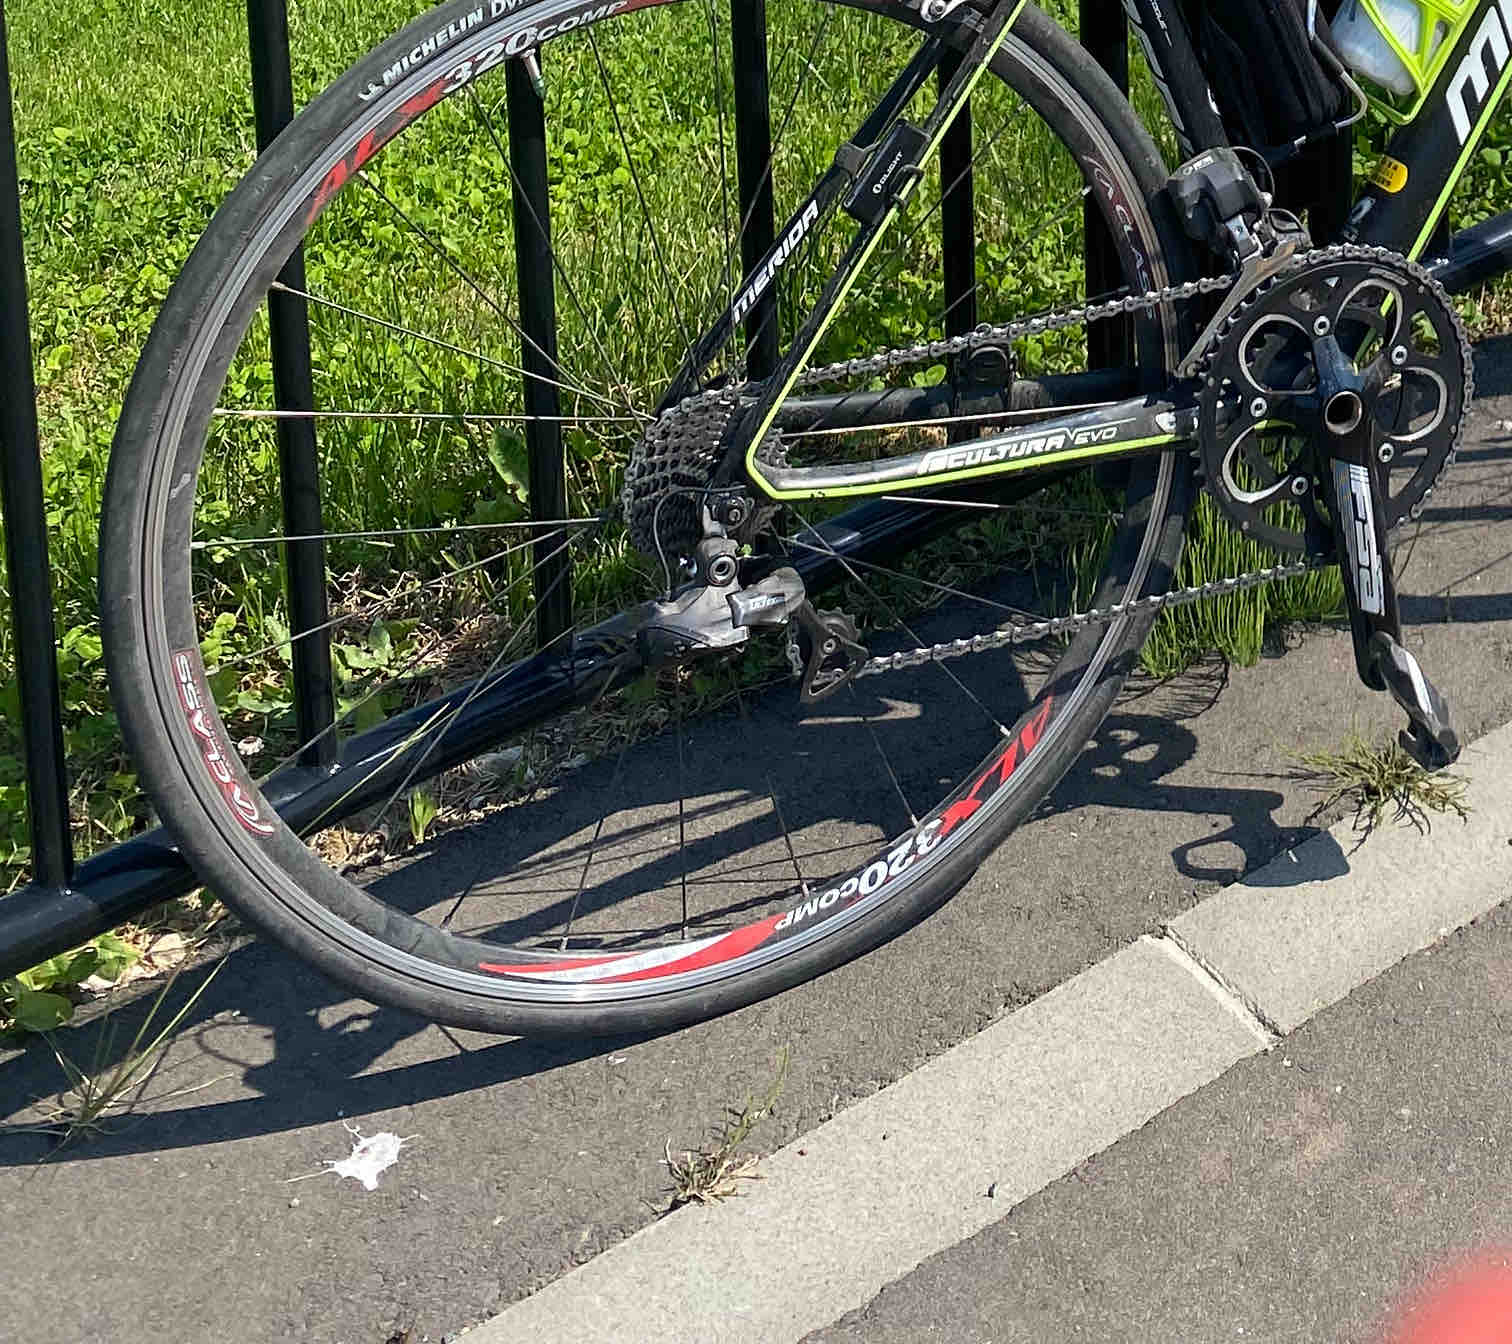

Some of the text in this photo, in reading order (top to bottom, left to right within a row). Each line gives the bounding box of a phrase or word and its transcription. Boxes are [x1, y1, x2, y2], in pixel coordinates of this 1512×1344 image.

[381, 4, 484, 88] MICHELIN
[880, 150, 904, 186] OLIGHT
[732, 198, 820, 325] MERIDA
[1073, 426, 1119, 445] EVO
[175, 654, 232, 785] CLASS
